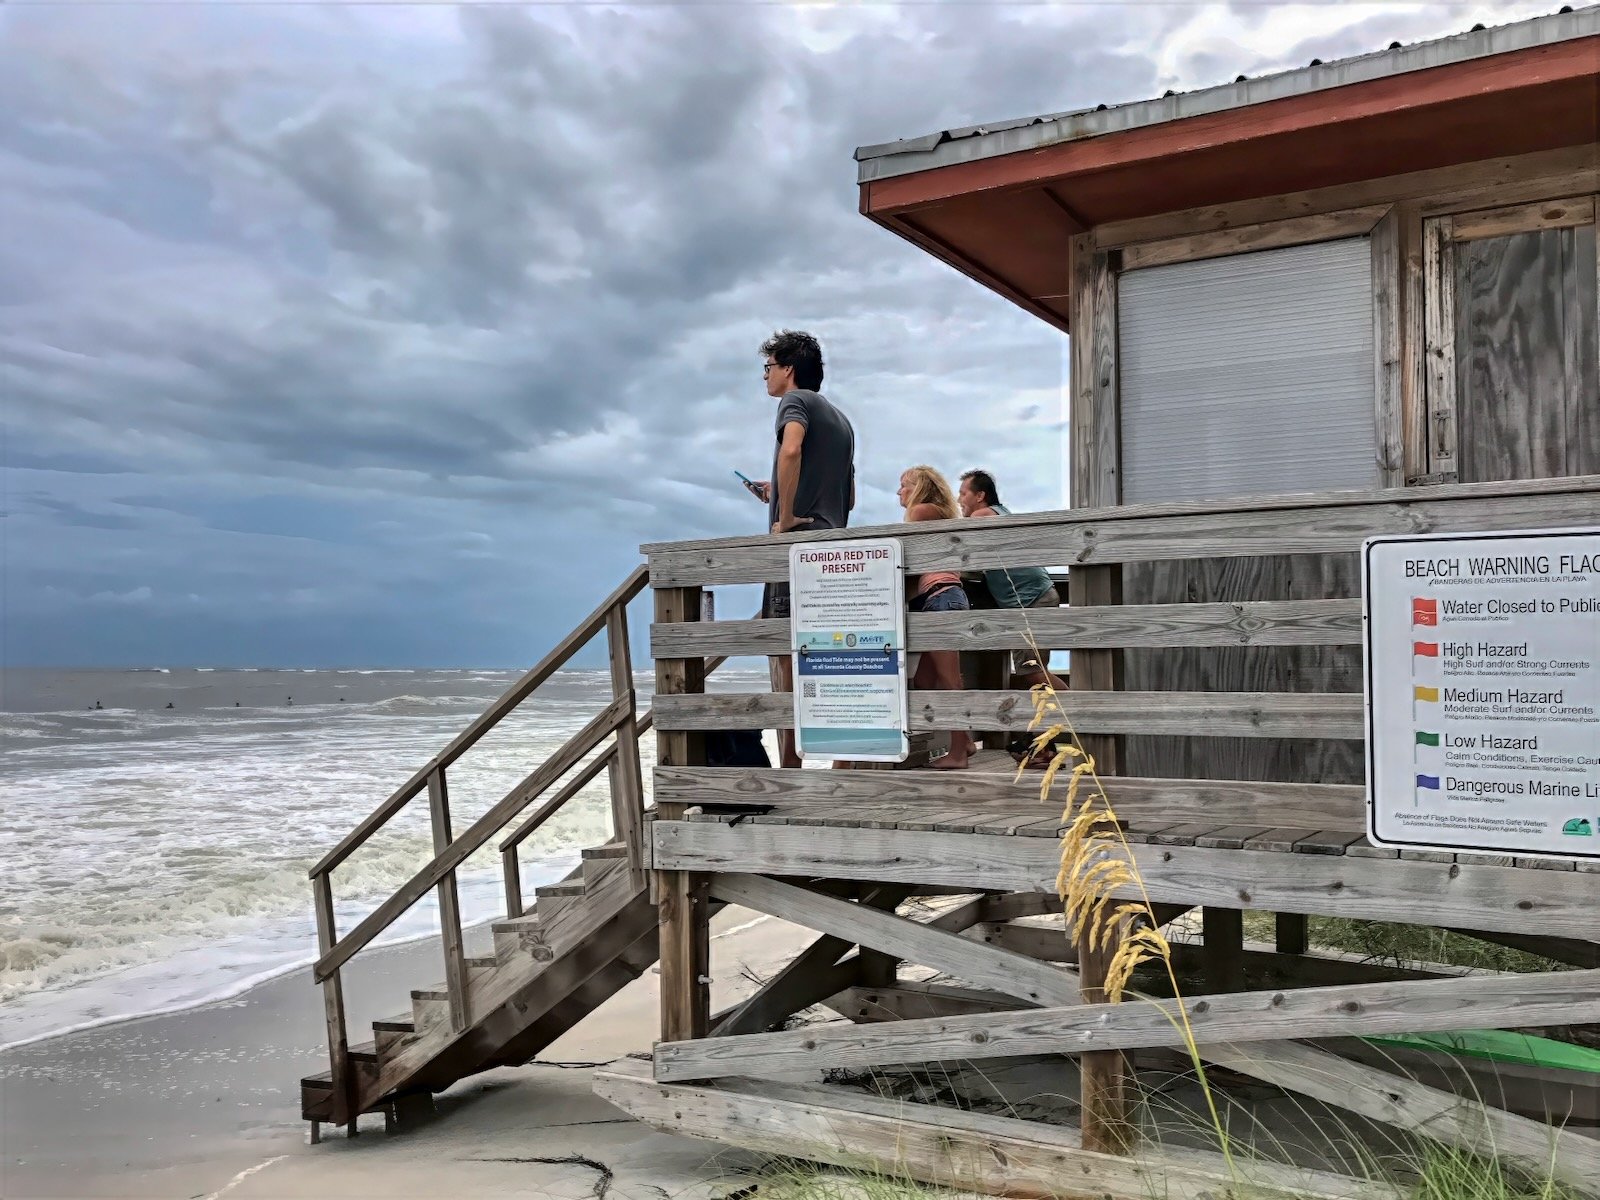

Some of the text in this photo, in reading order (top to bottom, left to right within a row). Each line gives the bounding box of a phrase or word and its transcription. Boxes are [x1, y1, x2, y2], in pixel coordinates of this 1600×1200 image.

[799, 549, 889, 563] FLORIDA RED TIDE
[822, 563, 866, 574] PRESENT
[1405, 558, 1460, 577] BEACH
[1468, 556, 1549, 576] WARNING
[1442, 600, 1483, 614] Water
[1487, 599, 1536, 614] Closed
[1542, 601, 1555, 613] to
[1443, 642, 1527, 660] High Hazard
[1443, 660, 1590, 670] High Surf and/or Strong Currents
[1444, 688, 1563, 704] Medium Hazard
[1444, 704, 1594, 714] Moderate Surf and/or Currents
[1445, 733, 1538, 750] Low Hazard
[1445, 751, 1470, 760] Calm
[1473, 753, 1528, 763] Conditions,
[1530, 755, 1574, 764] Exercise
[1446, 776, 1524, 796] Dangerous
[1529, 780, 1581, 797] Marine
[1394, 812, 1422, 820] Absence
